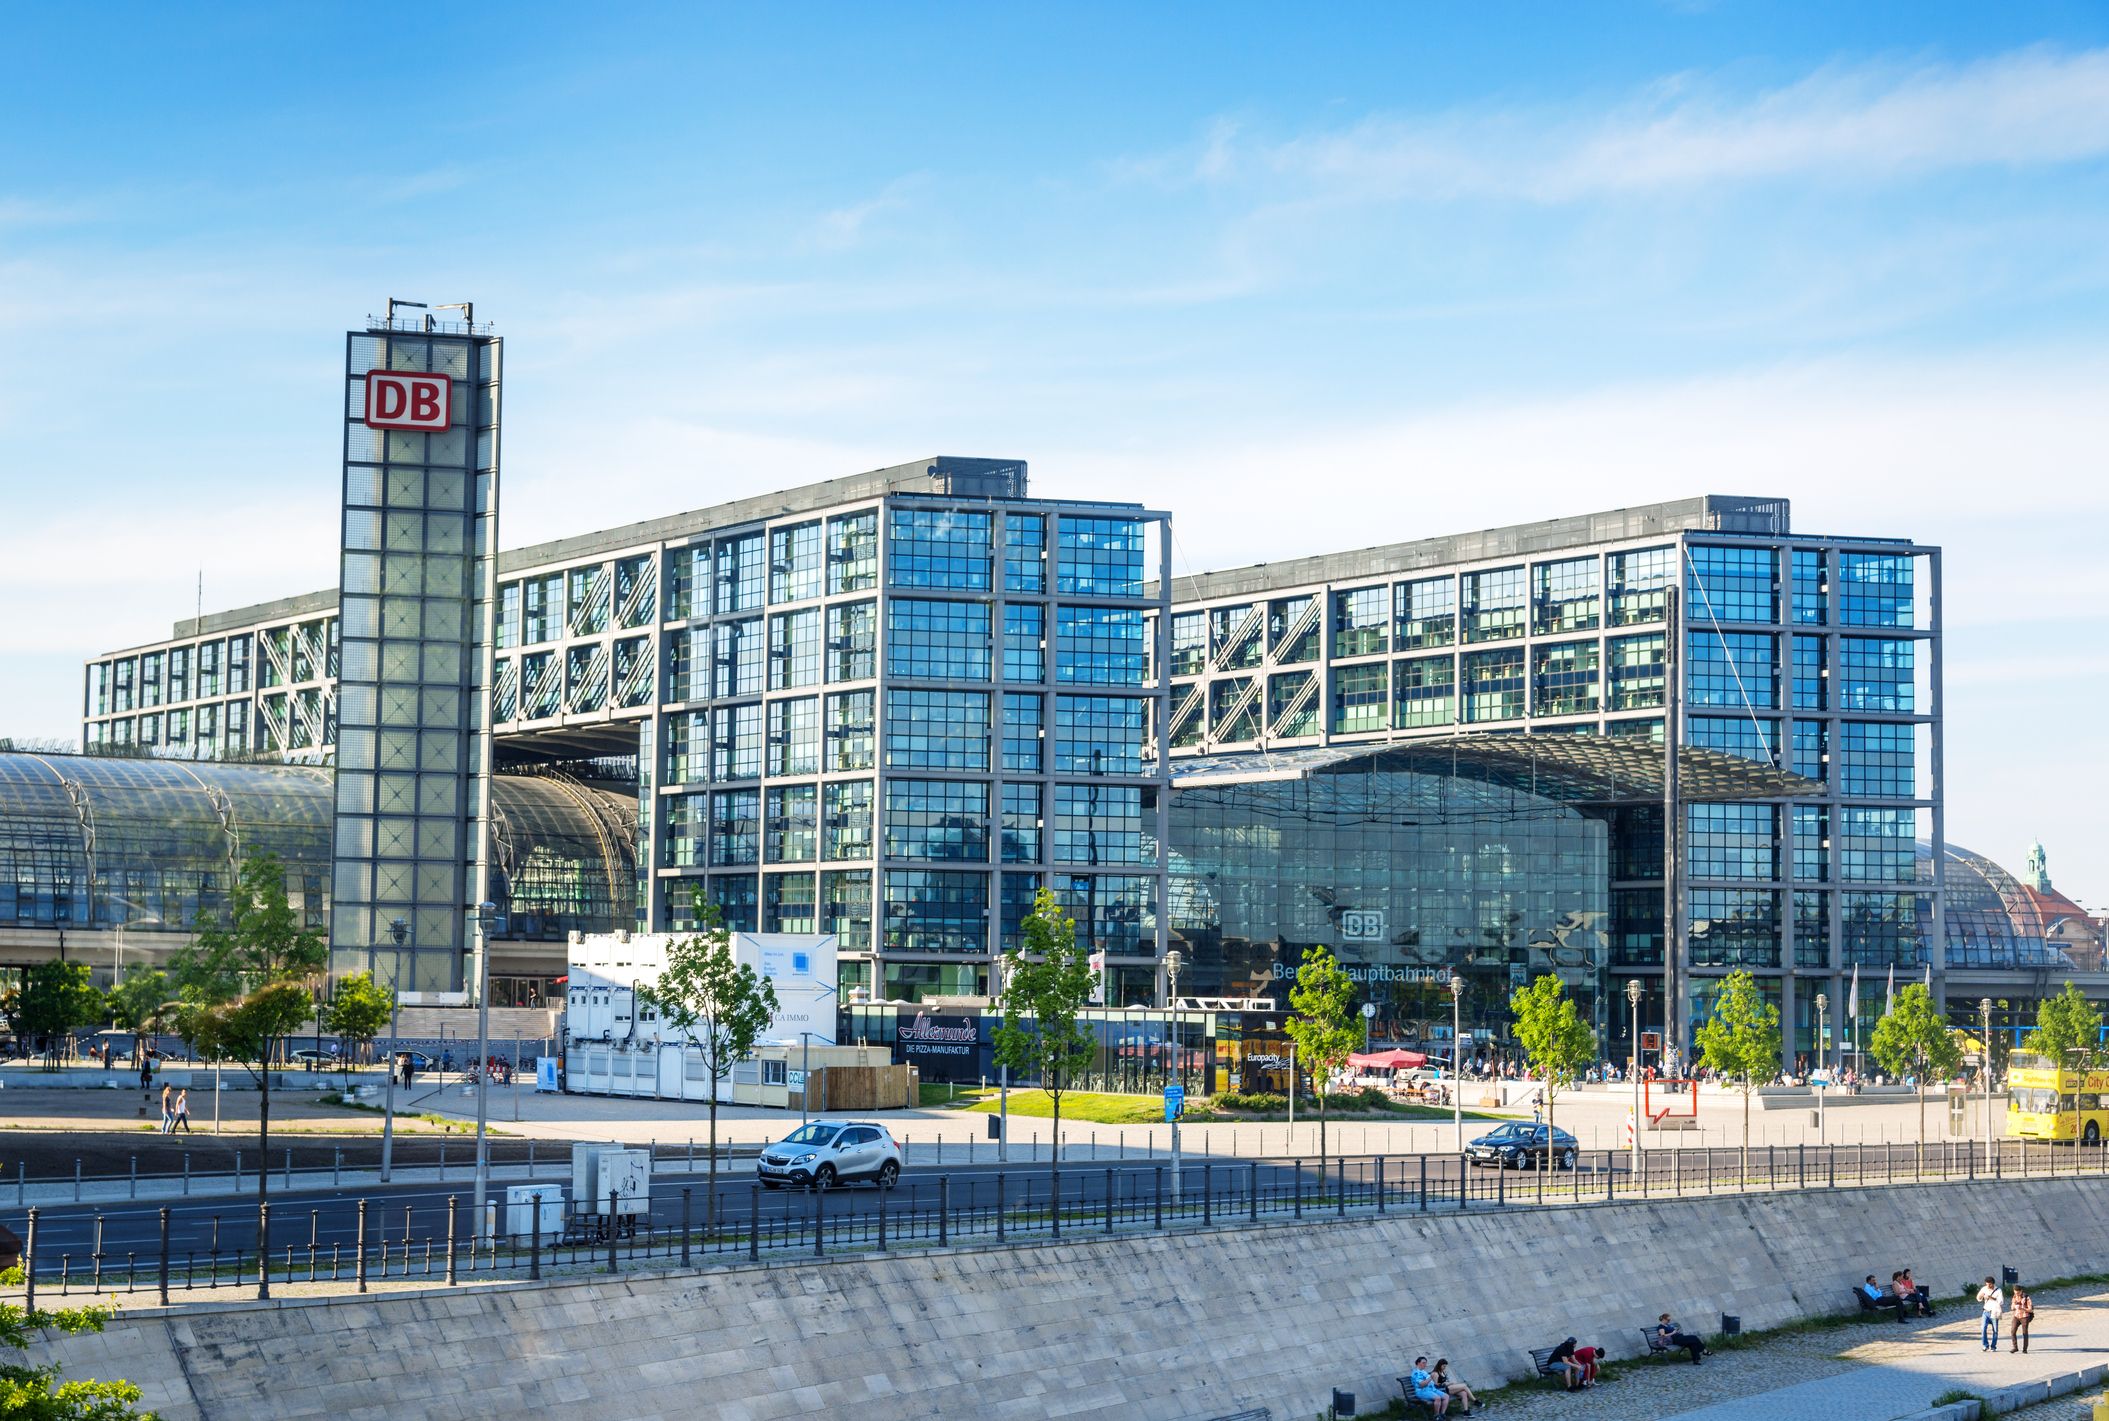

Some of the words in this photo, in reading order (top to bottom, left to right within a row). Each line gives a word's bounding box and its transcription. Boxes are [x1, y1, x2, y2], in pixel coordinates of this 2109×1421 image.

[376, 380, 440, 421] DB
[1348, 915, 1379, 936] DB
[787, 1014, 809, 1022] IMMO
[906, 1045, 915, 1053] DIE
[916, 1045, 970, 1055] PIZZA-MANUFAKTUR
[1247, 1053, 1281, 1064] Europacity
[2088, 1076, 2104, 1089] City
